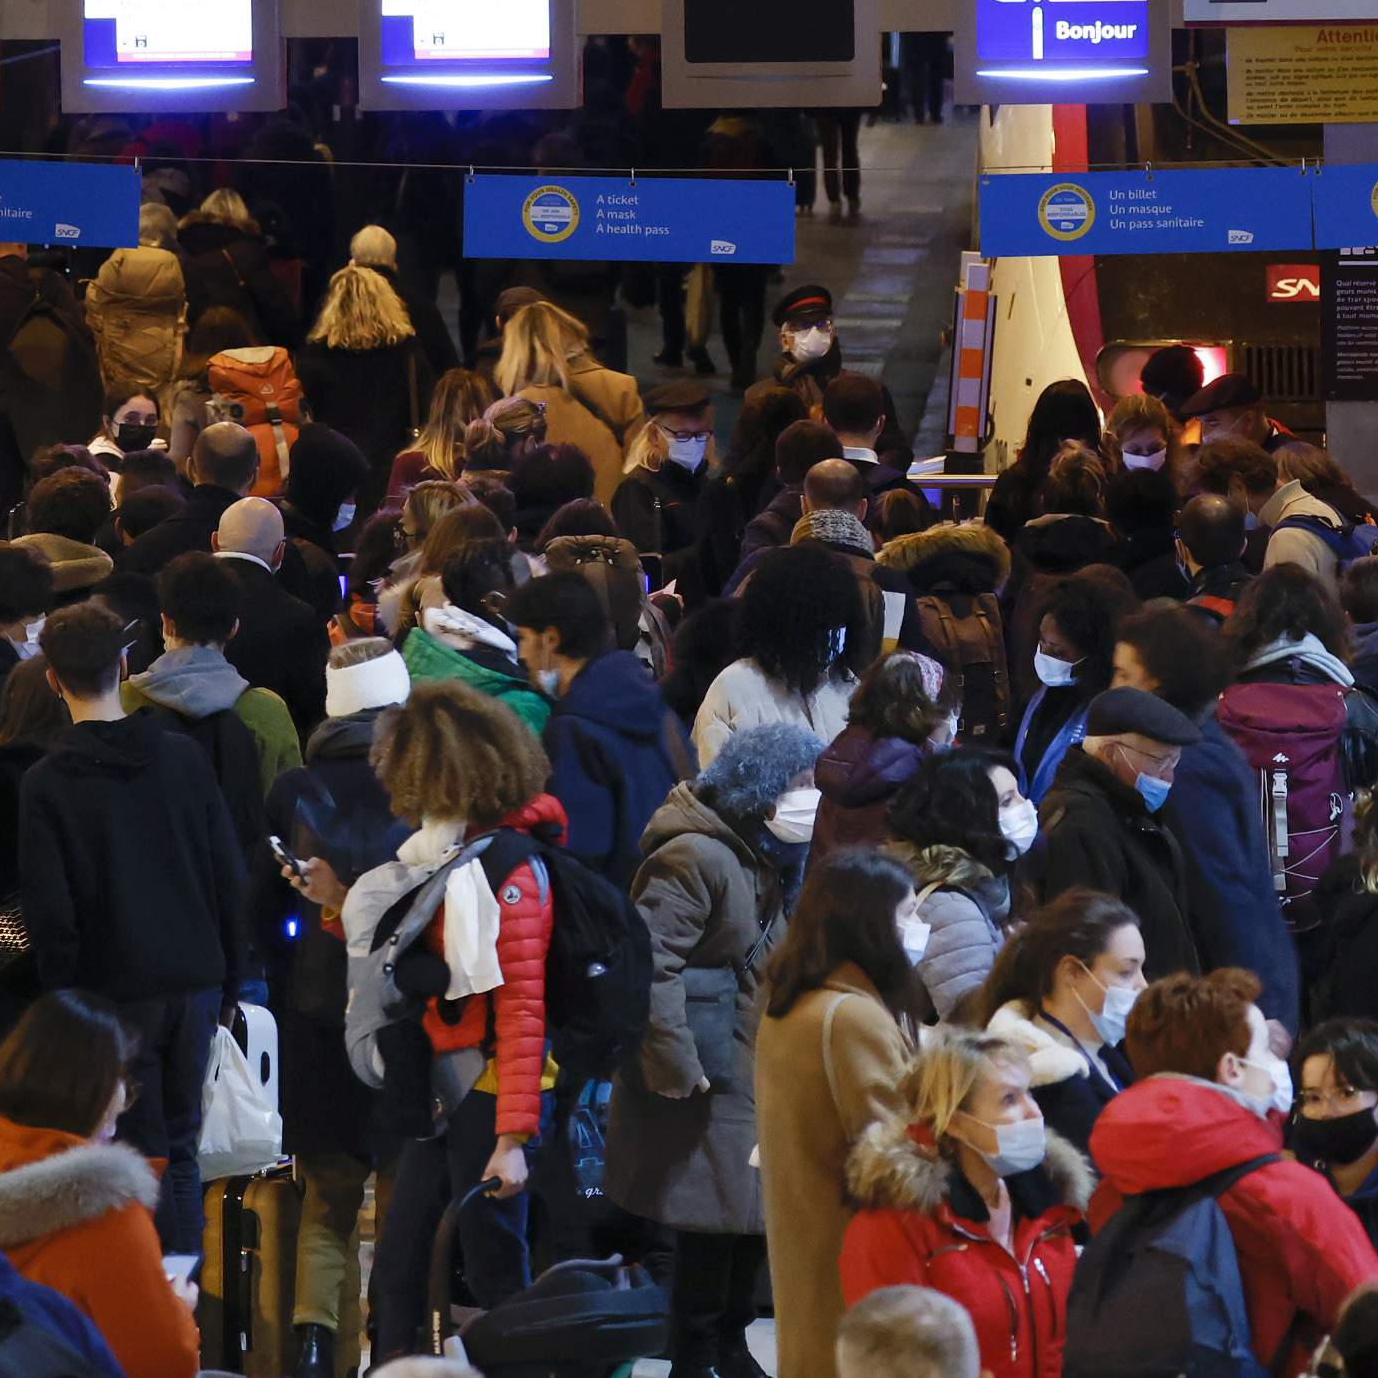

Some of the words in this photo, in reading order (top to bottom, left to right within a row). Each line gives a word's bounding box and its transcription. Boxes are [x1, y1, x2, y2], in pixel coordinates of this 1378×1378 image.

[1056, 21, 1137, 44] Bonjour
[597, 194, 604, 204] A
[607, 194, 639, 205] ticket
[1110, 190, 1125, 200] Un
[1128, 190, 1157, 200] billet
[597, 209, 604, 218] A
[607, 208, 636, 219] mask
[1110, 205, 1125, 215] Un
[1129, 204, 1172, 216] masque
[596, 223, 604, 232] A
[606, 223, 642, 234] health
[645, 225, 670, 237] pass
[1111, 219, 1125, 229] Un
[1129, 220, 1154, 231] pass
[1157, 217, 1203, 228] sanitaire
